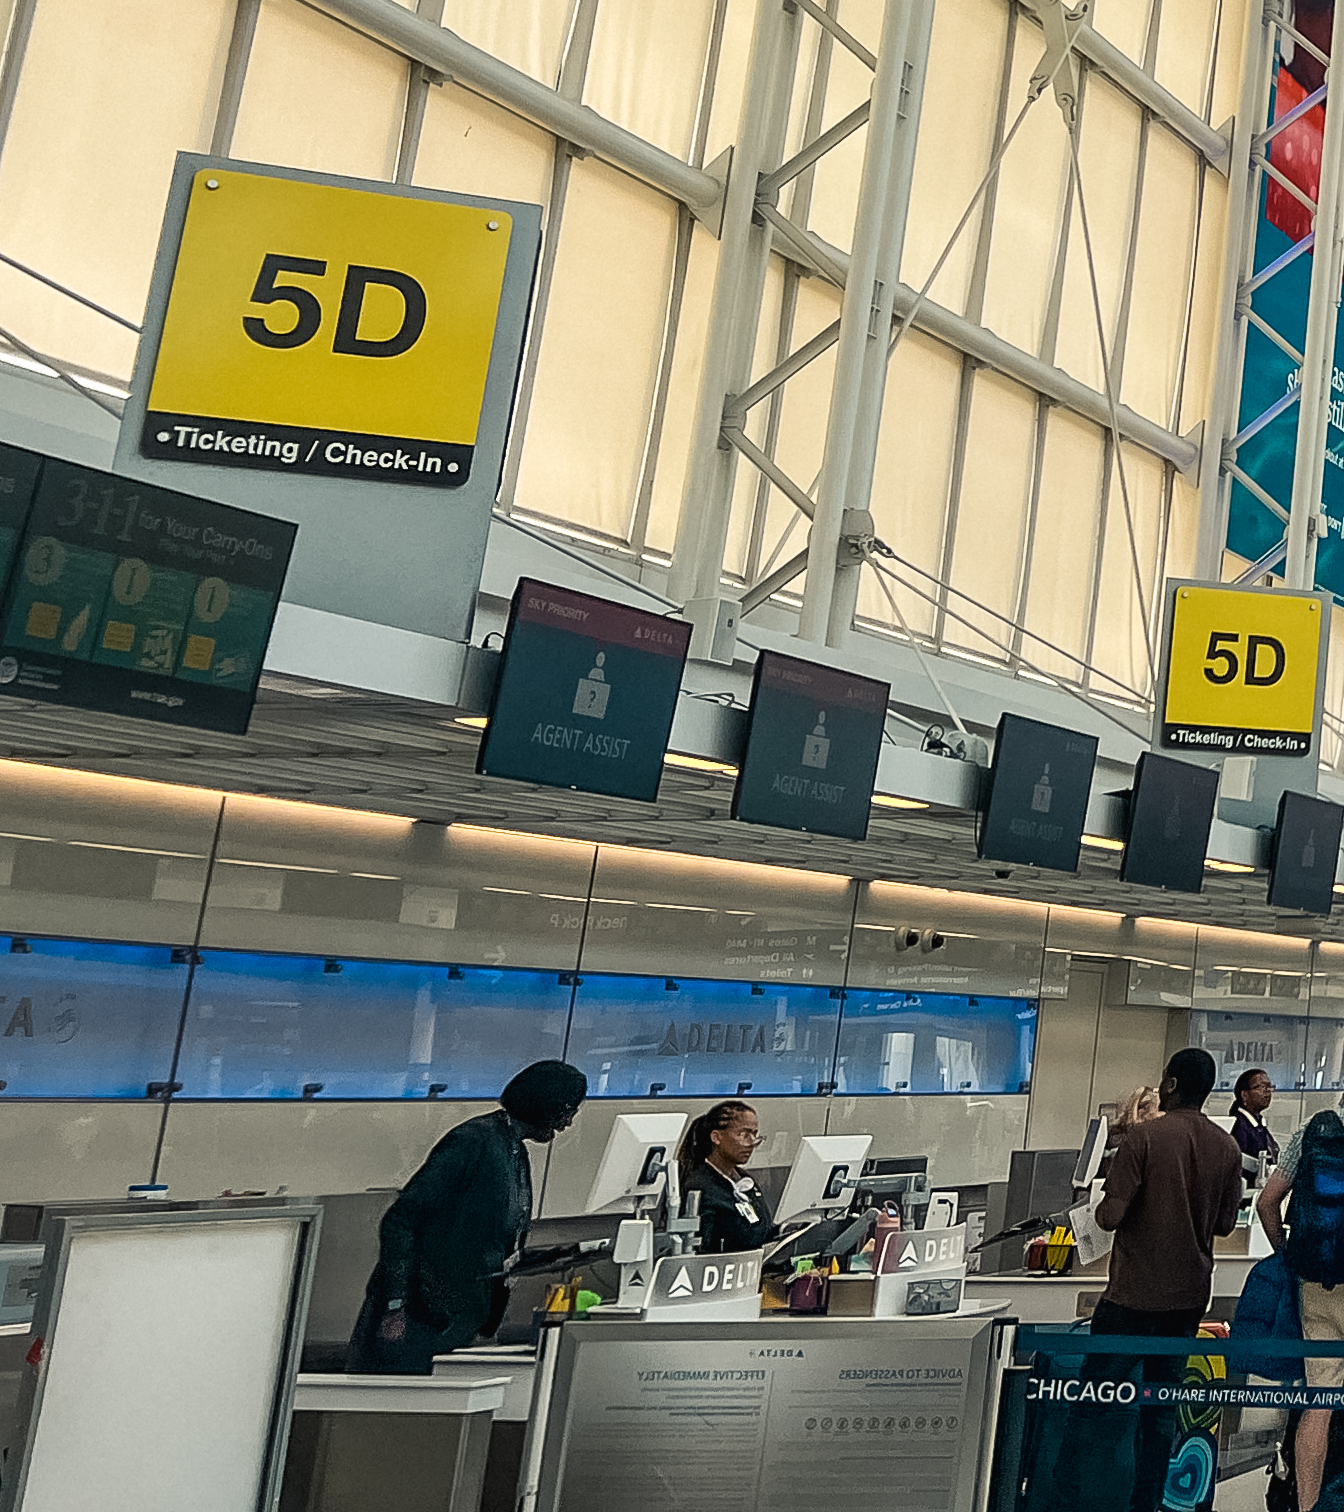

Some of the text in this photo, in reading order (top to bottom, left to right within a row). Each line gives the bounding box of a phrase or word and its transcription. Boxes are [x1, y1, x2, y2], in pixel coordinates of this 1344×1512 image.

[242, 253, 428, 359] 5D
[173, 426, 299, 464] Ticketing
[325, 442, 442, 474] Check-In
[164, 516, 201, 541] Your
[527, 596, 590, 623] SKY PRIORITY
[643, 627, 674, 646] DELTA
[1203, 630, 1286, 687] 5D
[531, 721, 631, 761] AGENT ASSIST
[1177, 729, 1234, 749] Ticketing
[1244, 734, 1298, 750] Check-In
[772, 773, 847, 804] AGENT ASSIST
[686, 1022, 766, 1054] DELTA
[923, 1234, 965, 1260] DELT
[701, 1260, 759, 1293] DELT
[1158, 1387, 1206, 1402] O'HARE
[1208, 1388, 1310, 1405] INTERNATIONAL
